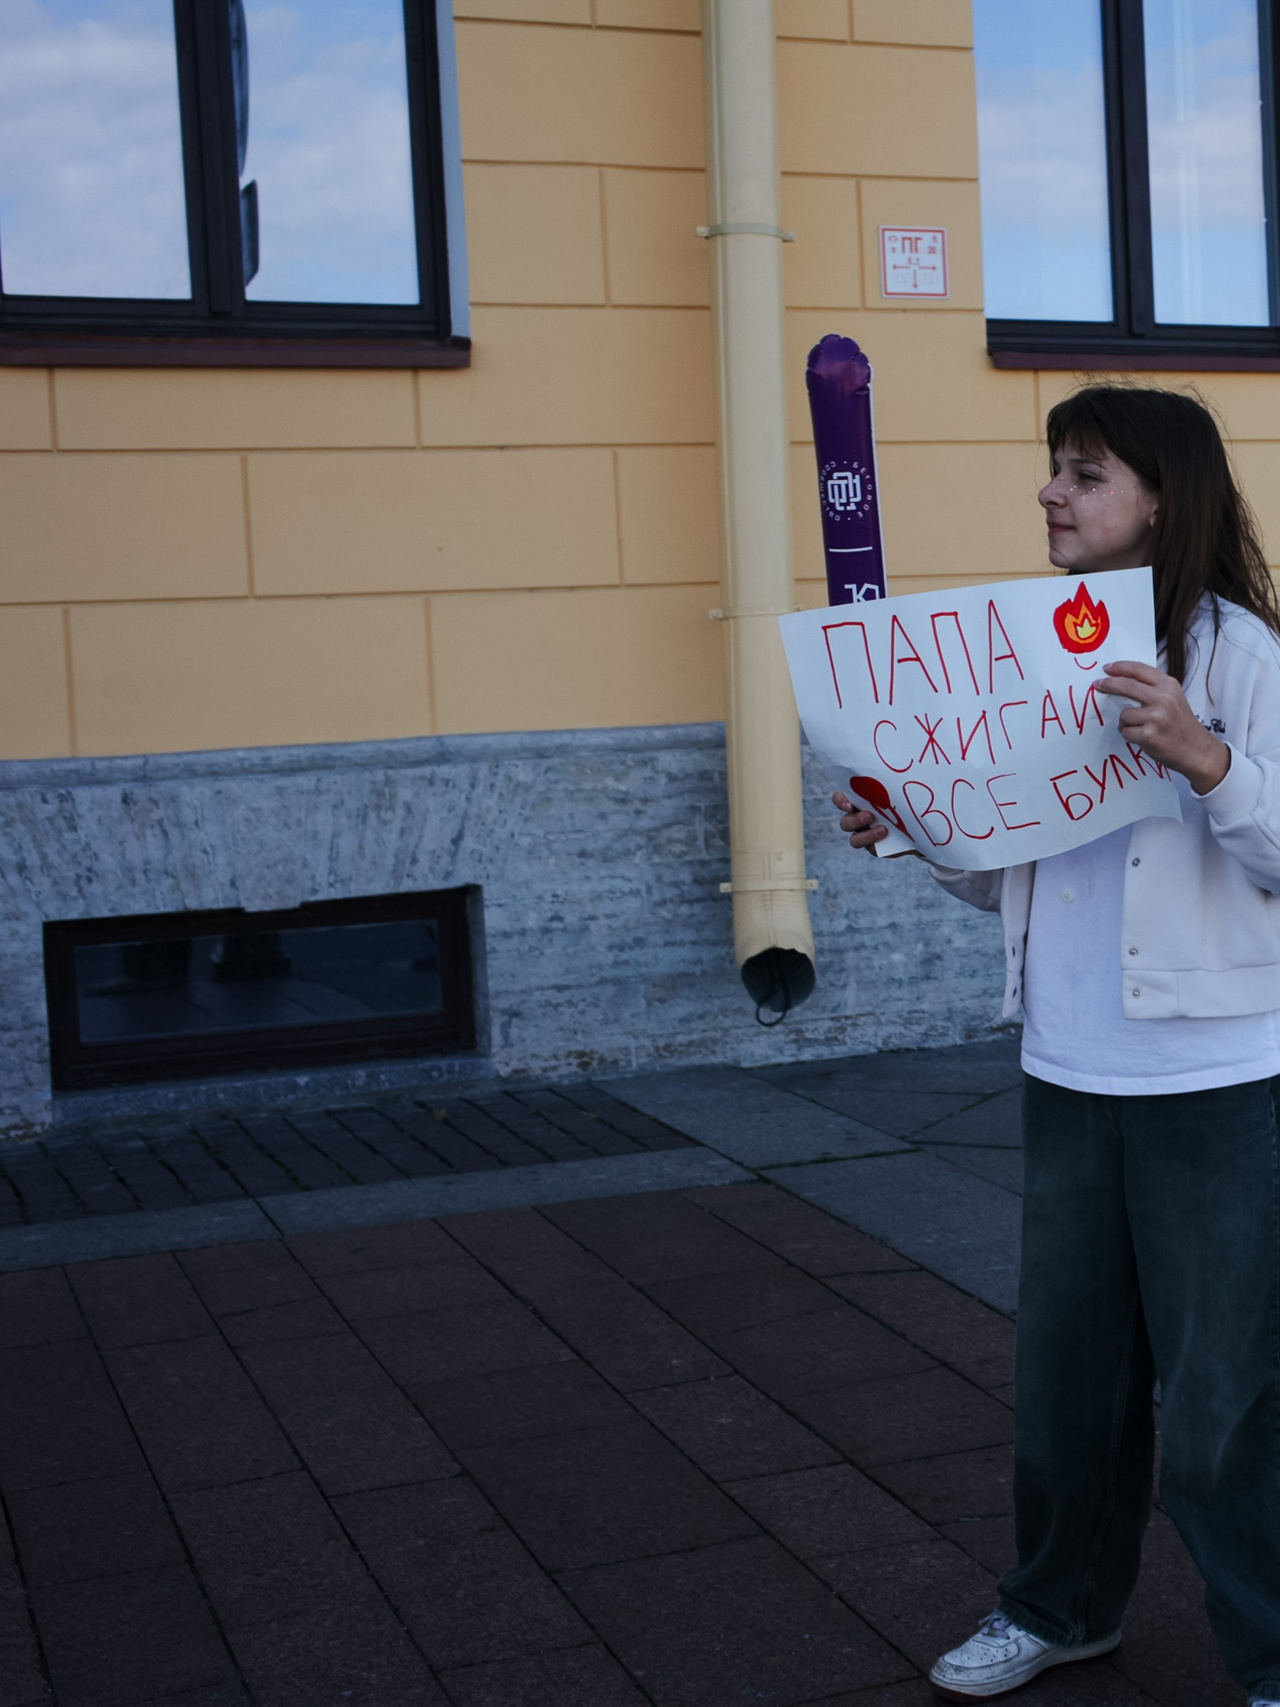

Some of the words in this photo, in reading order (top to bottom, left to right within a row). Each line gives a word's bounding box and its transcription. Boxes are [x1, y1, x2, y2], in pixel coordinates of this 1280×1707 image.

[902, 236, 922, 254] ПГ
[821, 599, 1025, 709] ПАПА
[874, 657, 1104, 773] СЖИГАЙ
[902, 773, 1042, 847] ВСЕ
